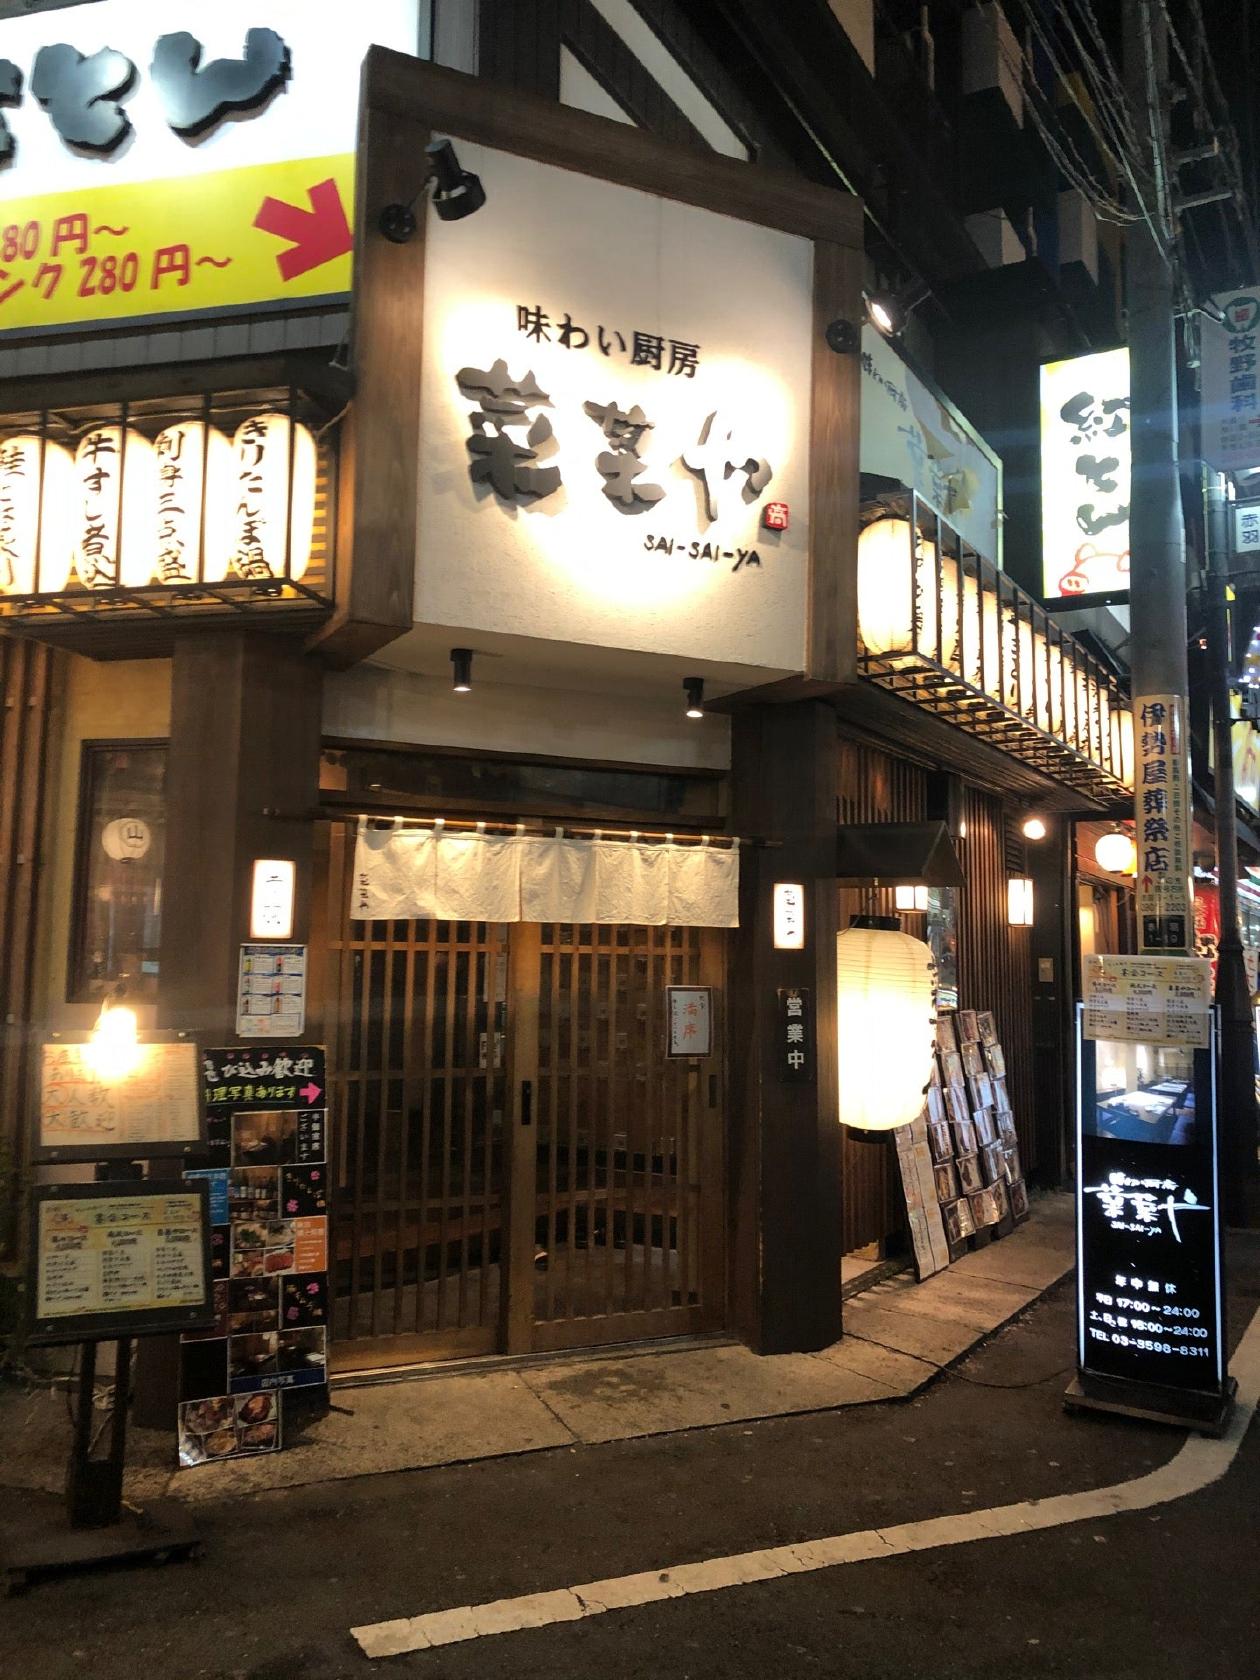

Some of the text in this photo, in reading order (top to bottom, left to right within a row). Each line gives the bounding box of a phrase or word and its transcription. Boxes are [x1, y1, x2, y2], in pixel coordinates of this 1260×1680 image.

[0, 27, 292, 165] とん
[516, 305, 701, 378] 味わい厨房
[1228, 333, 1256, 413] 牧野歯科
[643, 533, 763, 572] SAI-SAI-YA
[1241, 513, 1259, 545] 赤羽
[1141, 703, 1170, 872] 伊勢屋葬祭店
[786, 997, 806, 1070] 営業中
[1115, 1274, 1178, 1296] 年中無休
[1088, 1327, 1111, 1343] TEL
